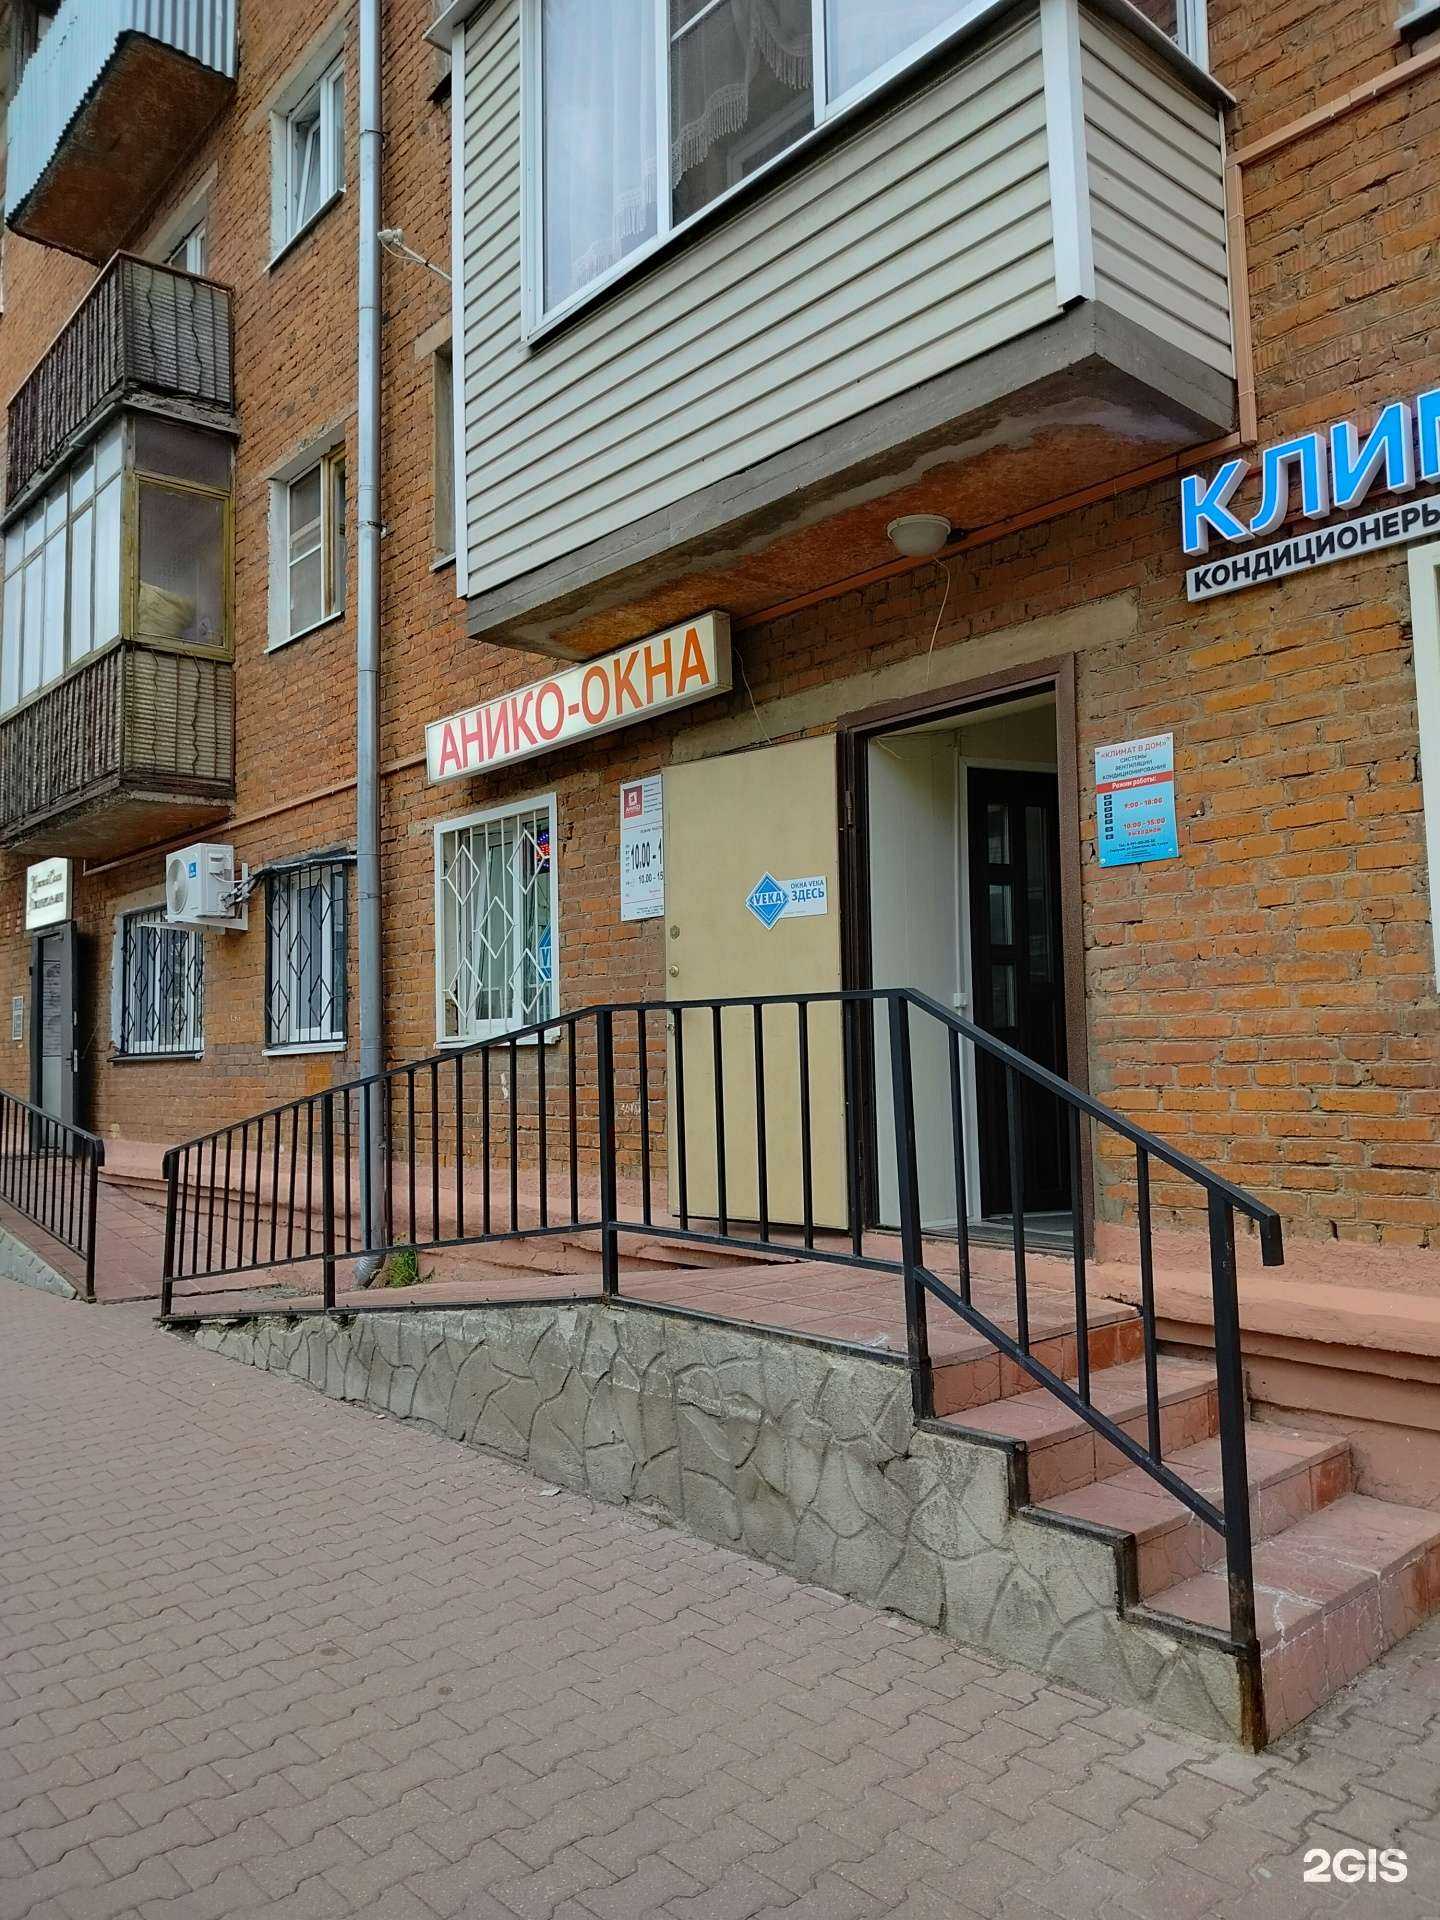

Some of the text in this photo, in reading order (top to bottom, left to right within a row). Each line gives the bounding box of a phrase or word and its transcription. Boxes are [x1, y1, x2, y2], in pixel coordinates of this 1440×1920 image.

[438, 627, 710, 777] АНИКО-ОКНА
[1115, 760, 1153, 771] ВЕНТИЛЯЦИИ
[1120, 754, 1147, 763] СИСТЕМЫ
[1103, 764, 1167, 780] КОНДИЦИОНИРОВАНИЯ
[631, 842, 650, 870] 10.00
[755, 891, 782, 904] VEKA
[791, 888, 825, 902] ЗДЕСЬ
